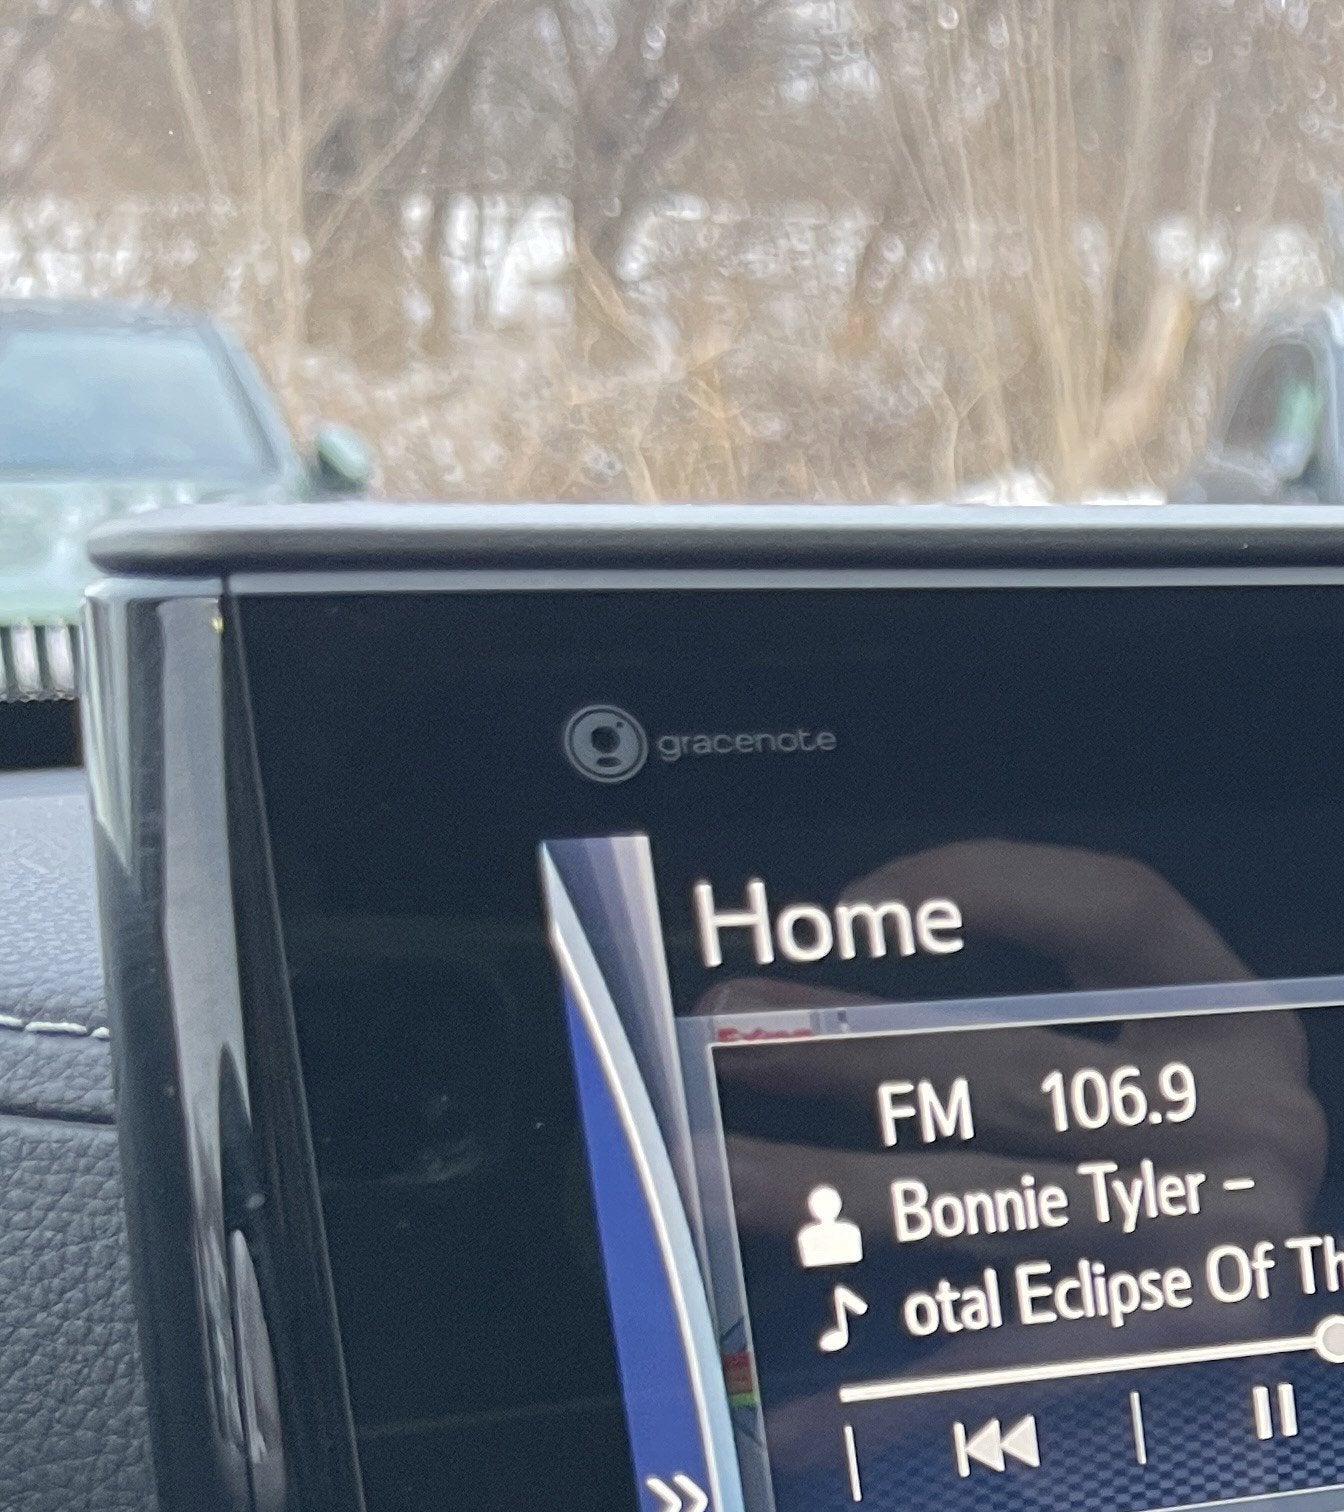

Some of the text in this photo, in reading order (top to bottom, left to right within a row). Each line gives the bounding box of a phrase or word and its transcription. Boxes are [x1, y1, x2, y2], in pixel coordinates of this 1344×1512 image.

[656, 724, 839, 762] gracenote
[695, 877, 965, 968] Home
[878, 1060, 1198, 1147] FM 106.9
[890, 1173, 1070, 1244] Bonnie
[1077, 1157, 1207, 1234] Tyler
[902, 1265, 1003, 1338] otal
[1014, 1257, 1193, 1328] Eclipse
[1206, 1240, 1275, 1302] Of
